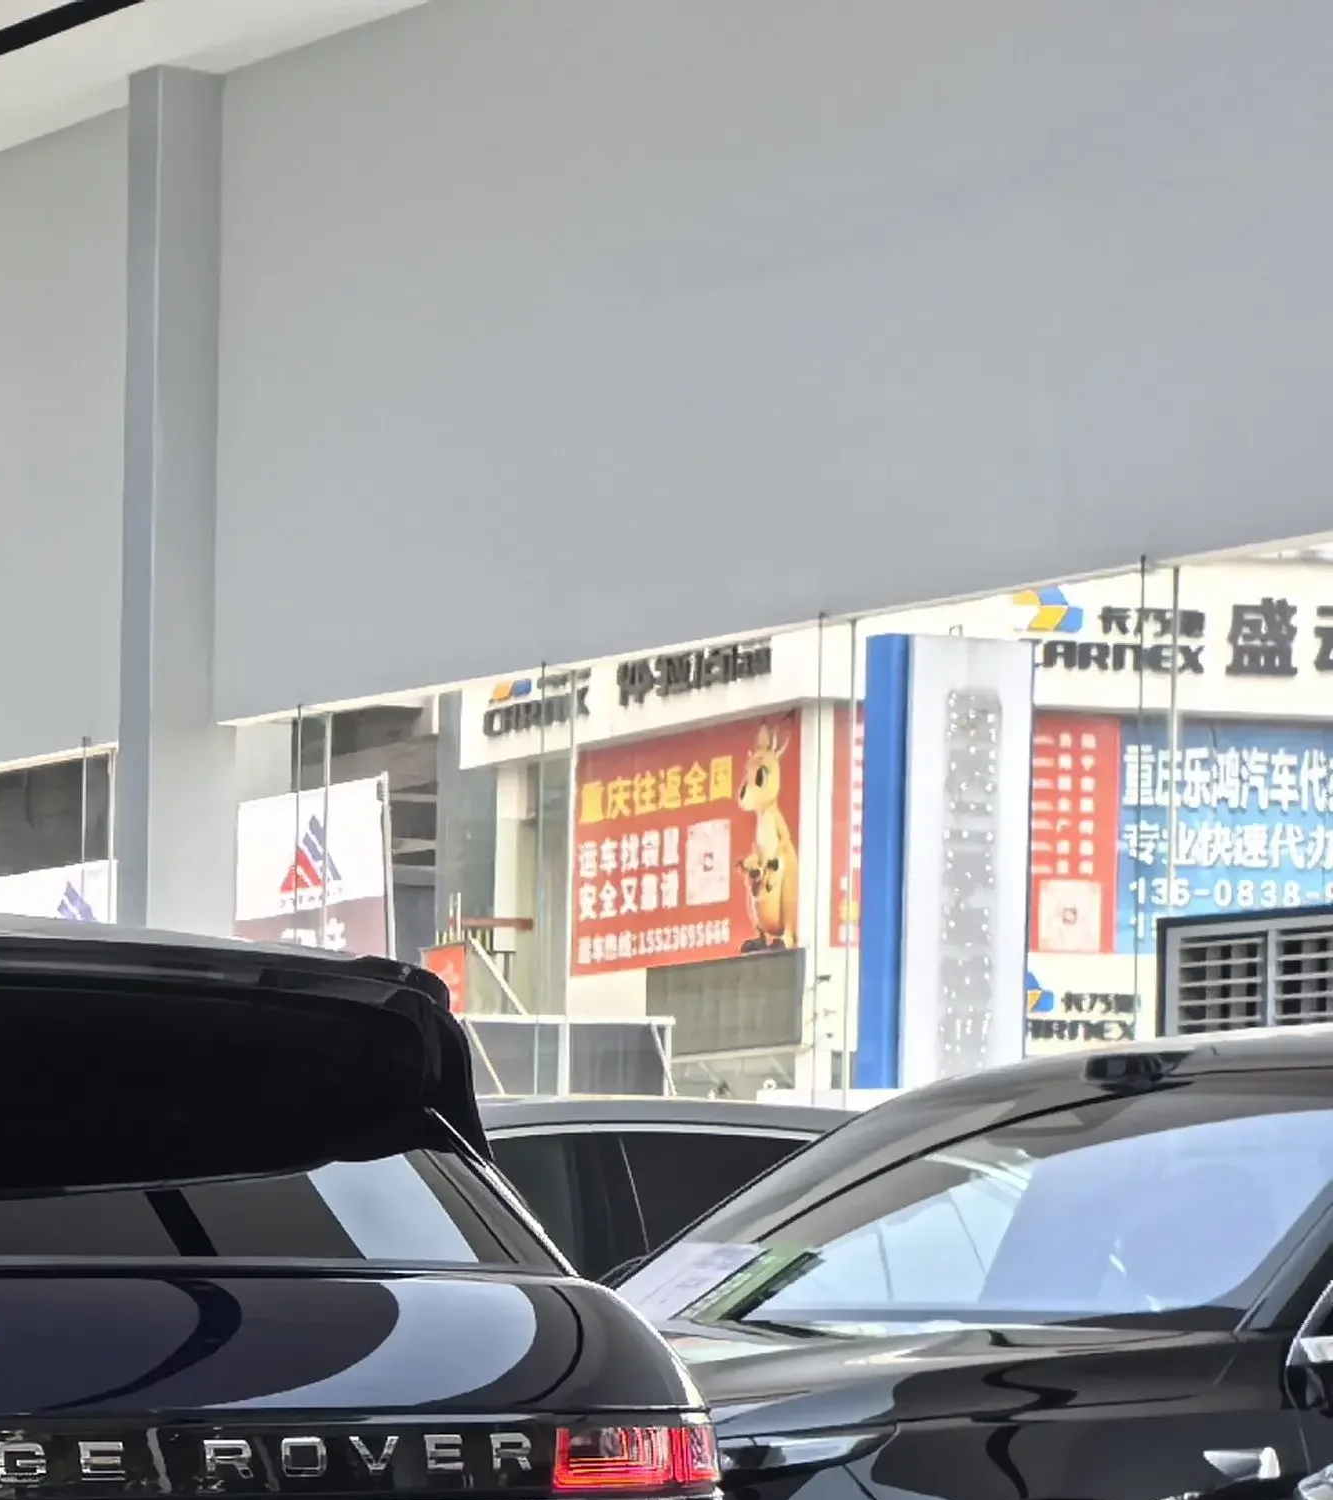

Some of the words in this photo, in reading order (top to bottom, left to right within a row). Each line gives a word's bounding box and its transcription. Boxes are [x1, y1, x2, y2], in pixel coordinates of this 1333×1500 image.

[1019, 639, 1206, 674] ARNEX
[580, 755, 733, 824] 重庆往返全国
[1123, 744, 1333, 816] 重庆乐鸿汽车代
[201, 1433, 532, 1480] ROVER
